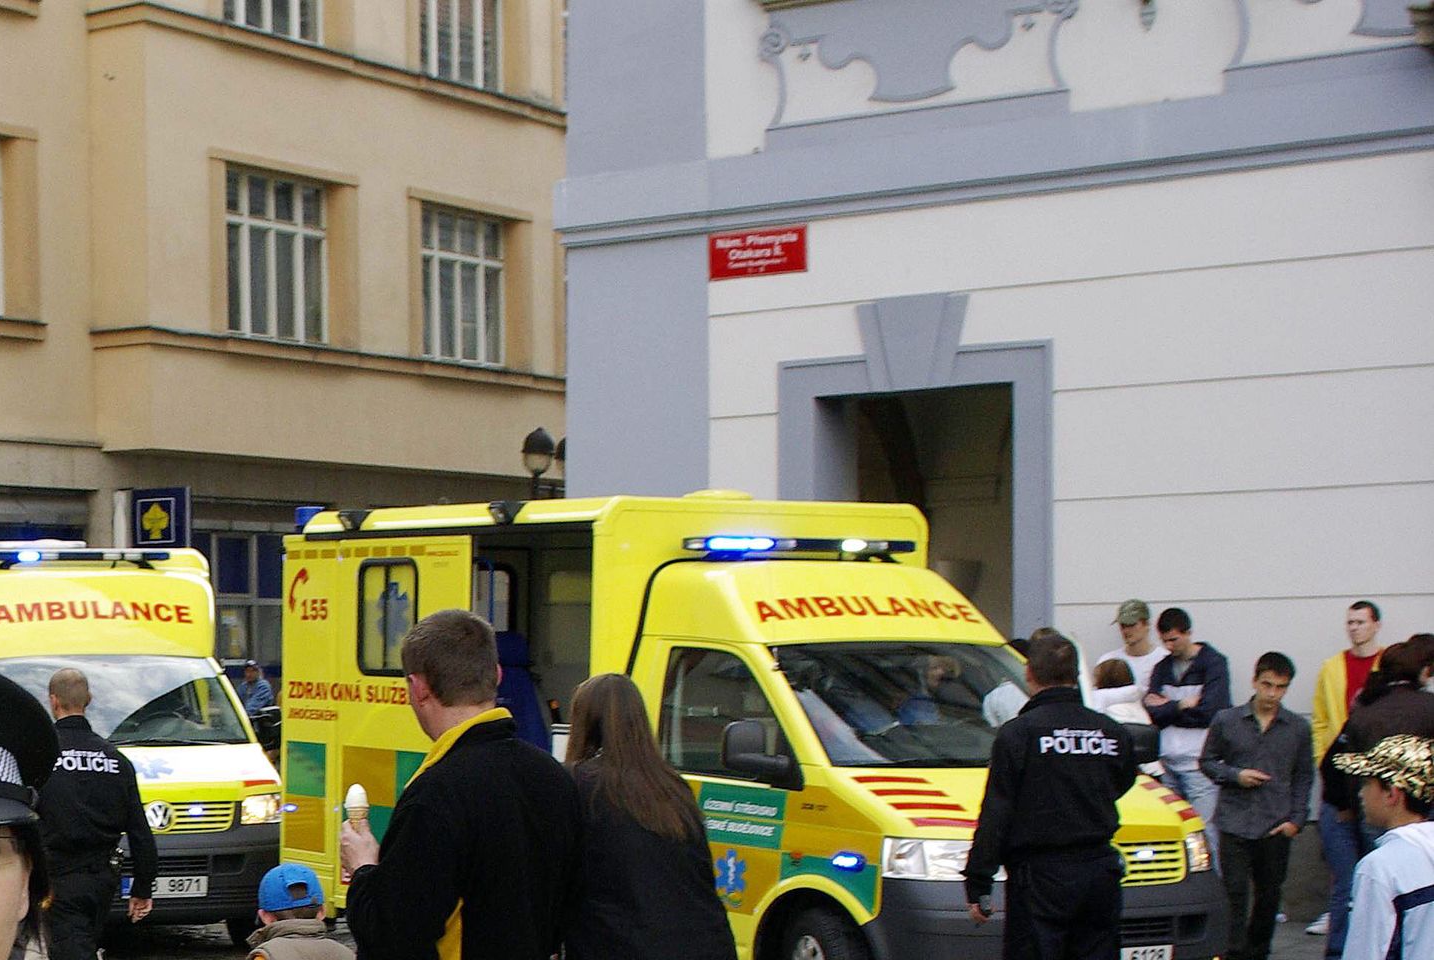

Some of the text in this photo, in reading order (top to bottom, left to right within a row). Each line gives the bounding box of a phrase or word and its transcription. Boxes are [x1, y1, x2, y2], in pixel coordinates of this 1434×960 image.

[300, 598, 329, 621] 155
[754, 595, 982, 624] AMBULANCE
[366, 682, 411, 706] SLUŽB
[1039, 735, 1120, 756] POLICIE
[52, 756, 121, 775] POLICIE
[168, 878, 202, 892] 9871
